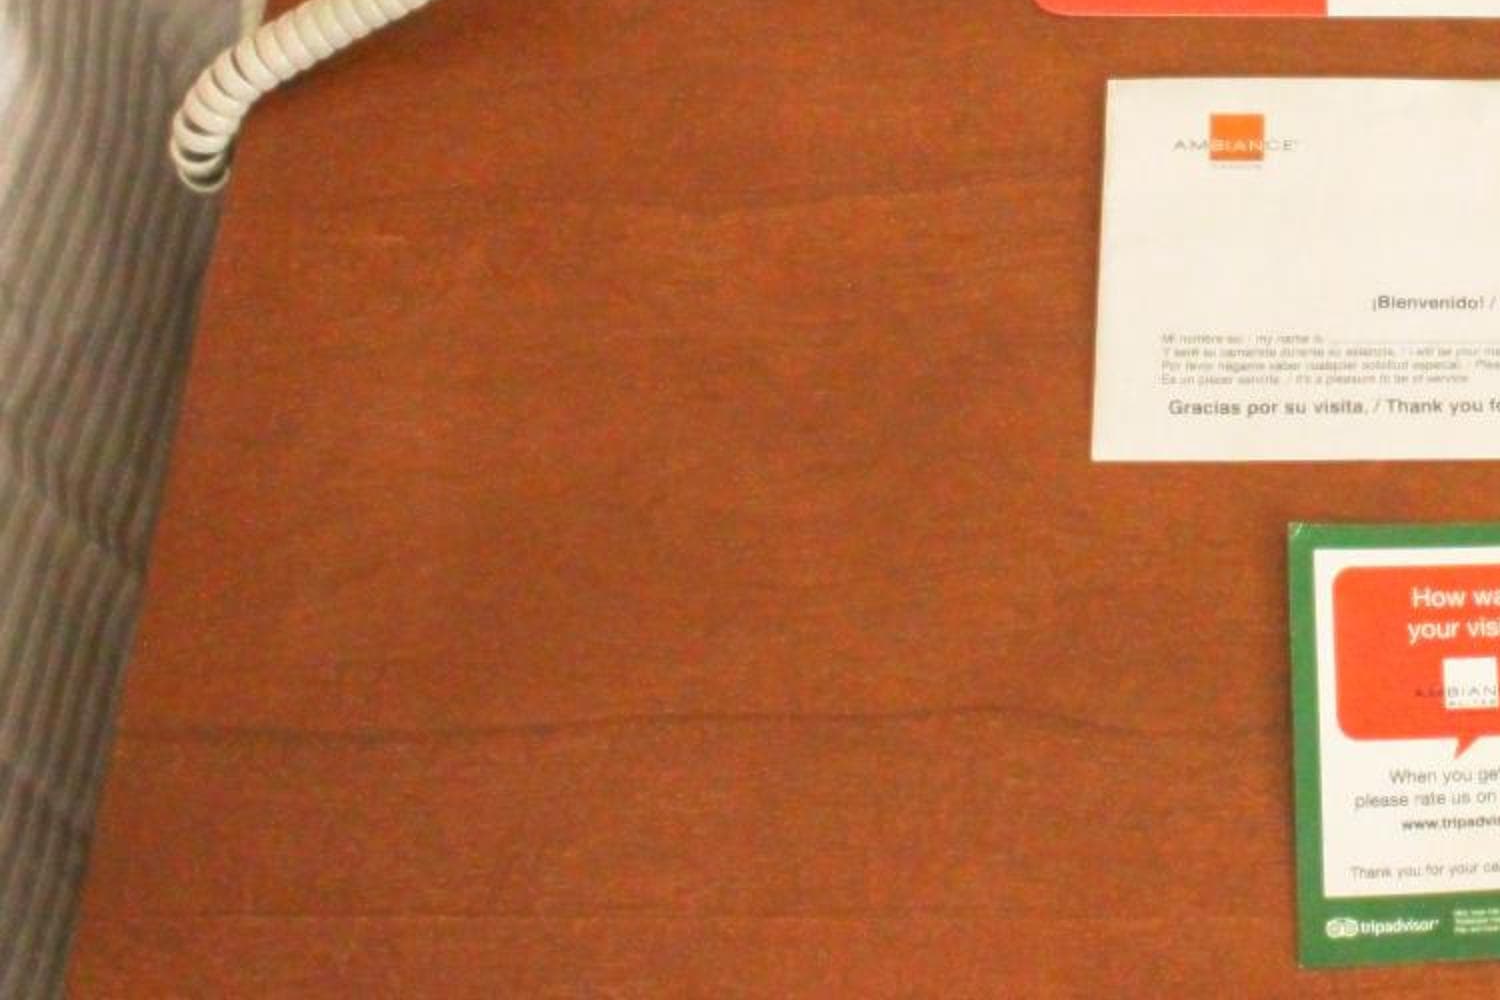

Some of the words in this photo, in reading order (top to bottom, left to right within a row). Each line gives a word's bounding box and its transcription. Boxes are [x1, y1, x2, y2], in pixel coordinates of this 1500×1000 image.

[1373, 296, 1484, 311] ¡Bienvenido!
[1168, 399, 1241, 414] Gracias
[1248, 400, 1279, 417] por
[1284, 402, 1307, 414] su
[1372, 399, 1381, 414] /
[1386, 398, 1443, 413] Thank
[1450, 400, 1483, 416] you
[1411, 586, 1466, 608] How
[1408, 619, 1459, 646] your
[1389, 767, 1438, 785] When
[1443, 769, 1474, 786] you
[1354, 791, 1409, 811] please
[1413, 789, 1446, 806] rate
[1451, 792, 1472, 806] us
[1475, 790, 1497, 804] on
[1350, 864, 1393, 881] Thank
[1397, 867, 1422, 881] you
[1425, 863, 1445, 877] for
[1449, 862, 1478, 879] your
[1359, 918, 1436, 937] tripadvisor
